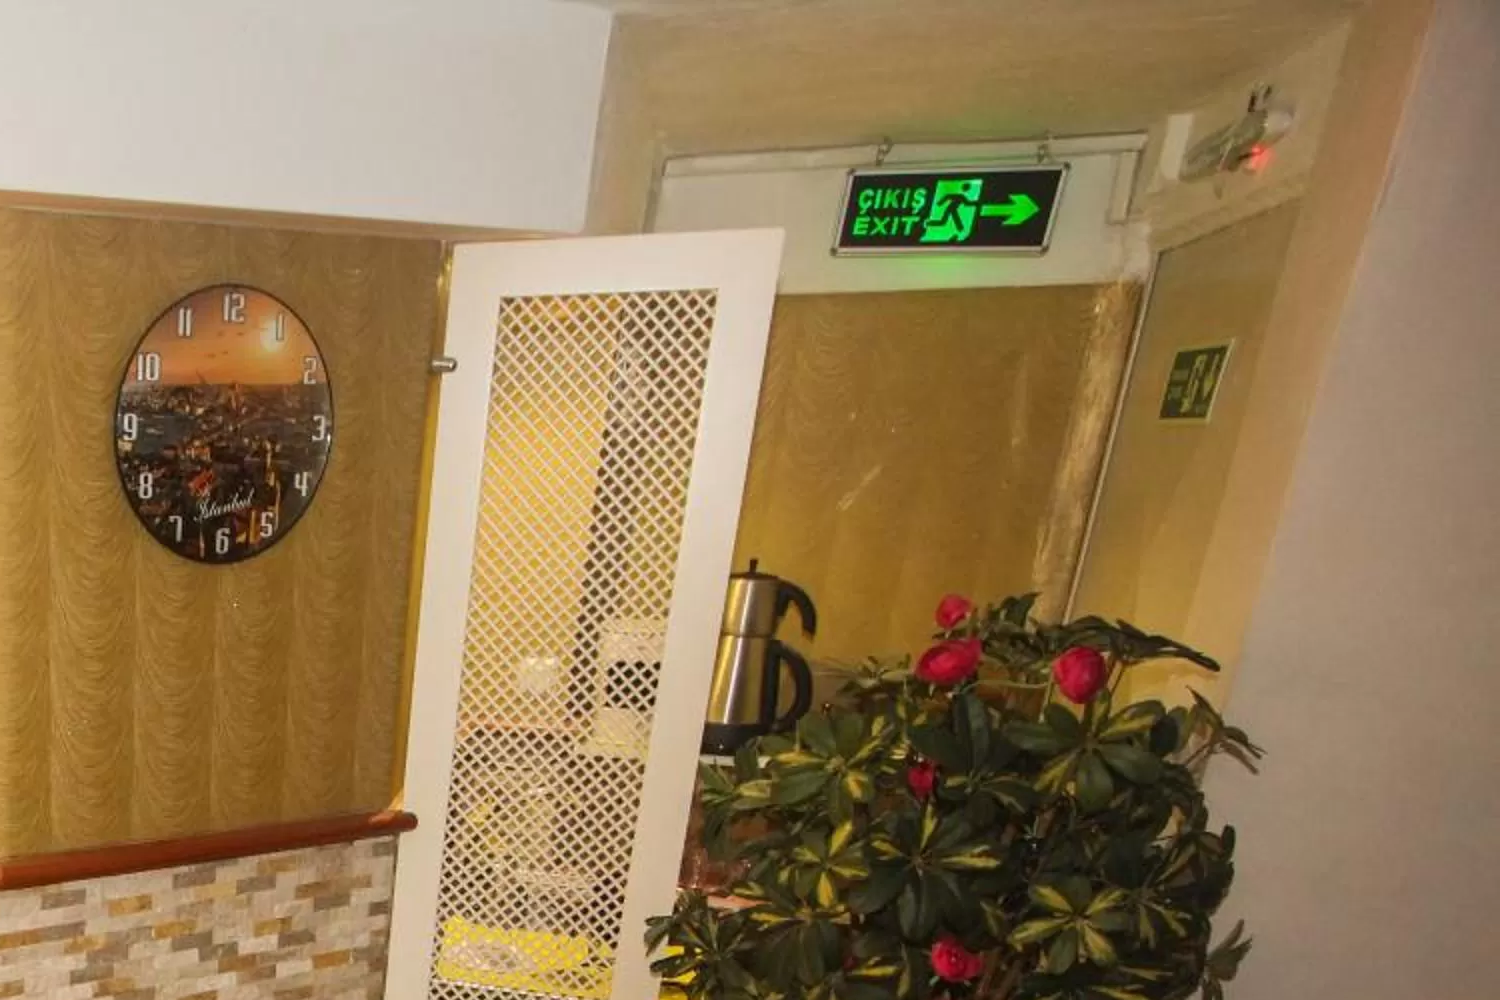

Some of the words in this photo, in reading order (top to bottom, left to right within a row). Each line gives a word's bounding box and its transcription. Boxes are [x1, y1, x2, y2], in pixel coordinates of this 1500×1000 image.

[858, 188, 927, 214] ÇIKIŞ
[852, 215, 921, 235] EXIT
[224, 293, 245, 322] 12
[178, 308, 192, 337] 11
[276, 313, 284, 341] 1
[137, 353, 160, 381] 10
[303, 356, 317, 385] 2
[123, 413, 138, 441] 9
[311, 415, 326, 442] 3
[139, 472, 153, 500] 8
[295, 471, 309, 497] 4
[169, 515, 183, 543] 7
[260, 512, 274, 537] 5
[215, 528, 230, 554] 6
